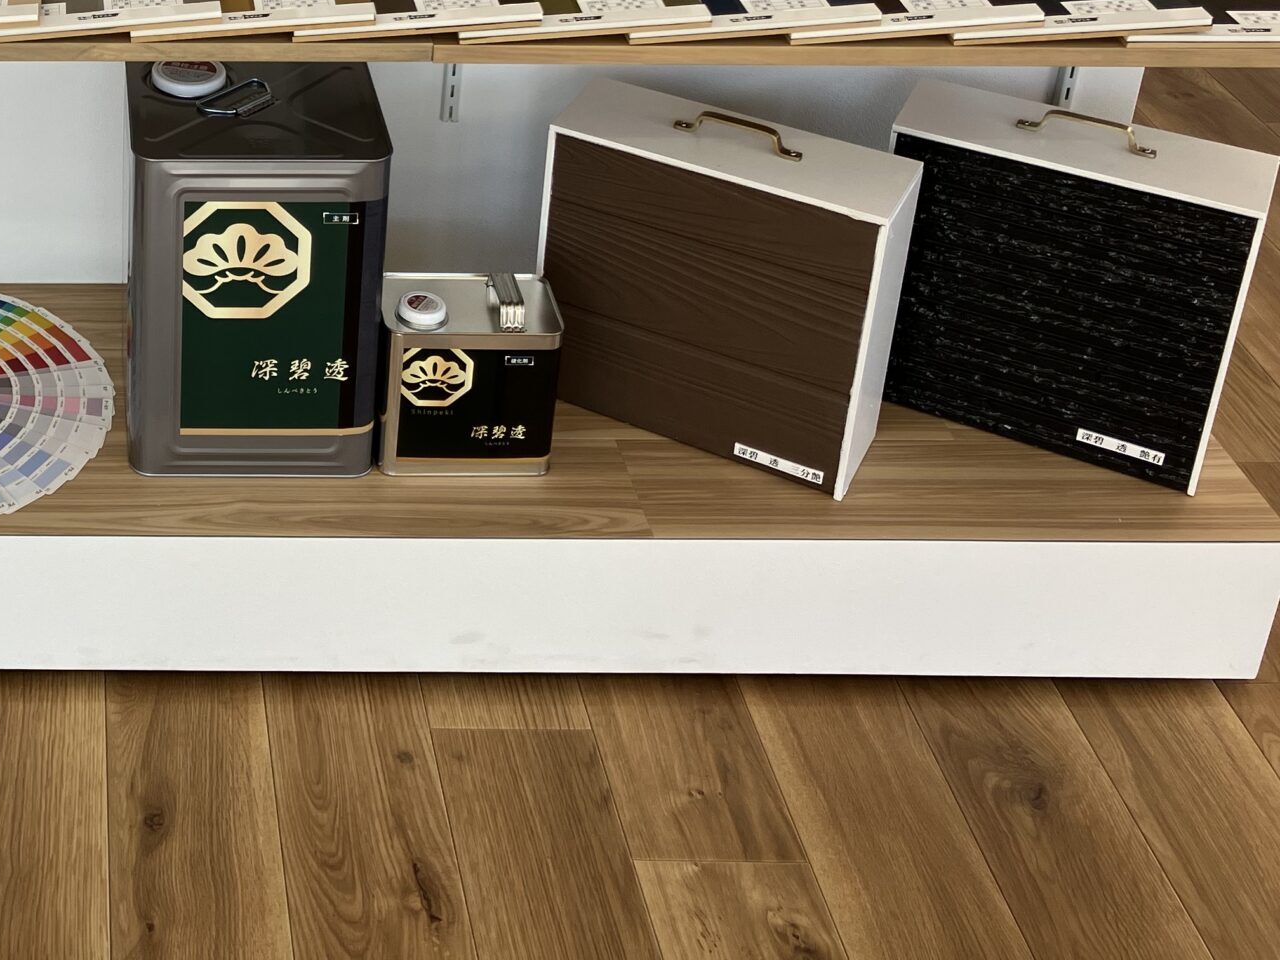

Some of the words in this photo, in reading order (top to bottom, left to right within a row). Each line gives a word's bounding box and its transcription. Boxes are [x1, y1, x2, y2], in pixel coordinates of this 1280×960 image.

[251, 358, 350, 381] 深碧透
[470, 425, 527, 439] 深碧透
